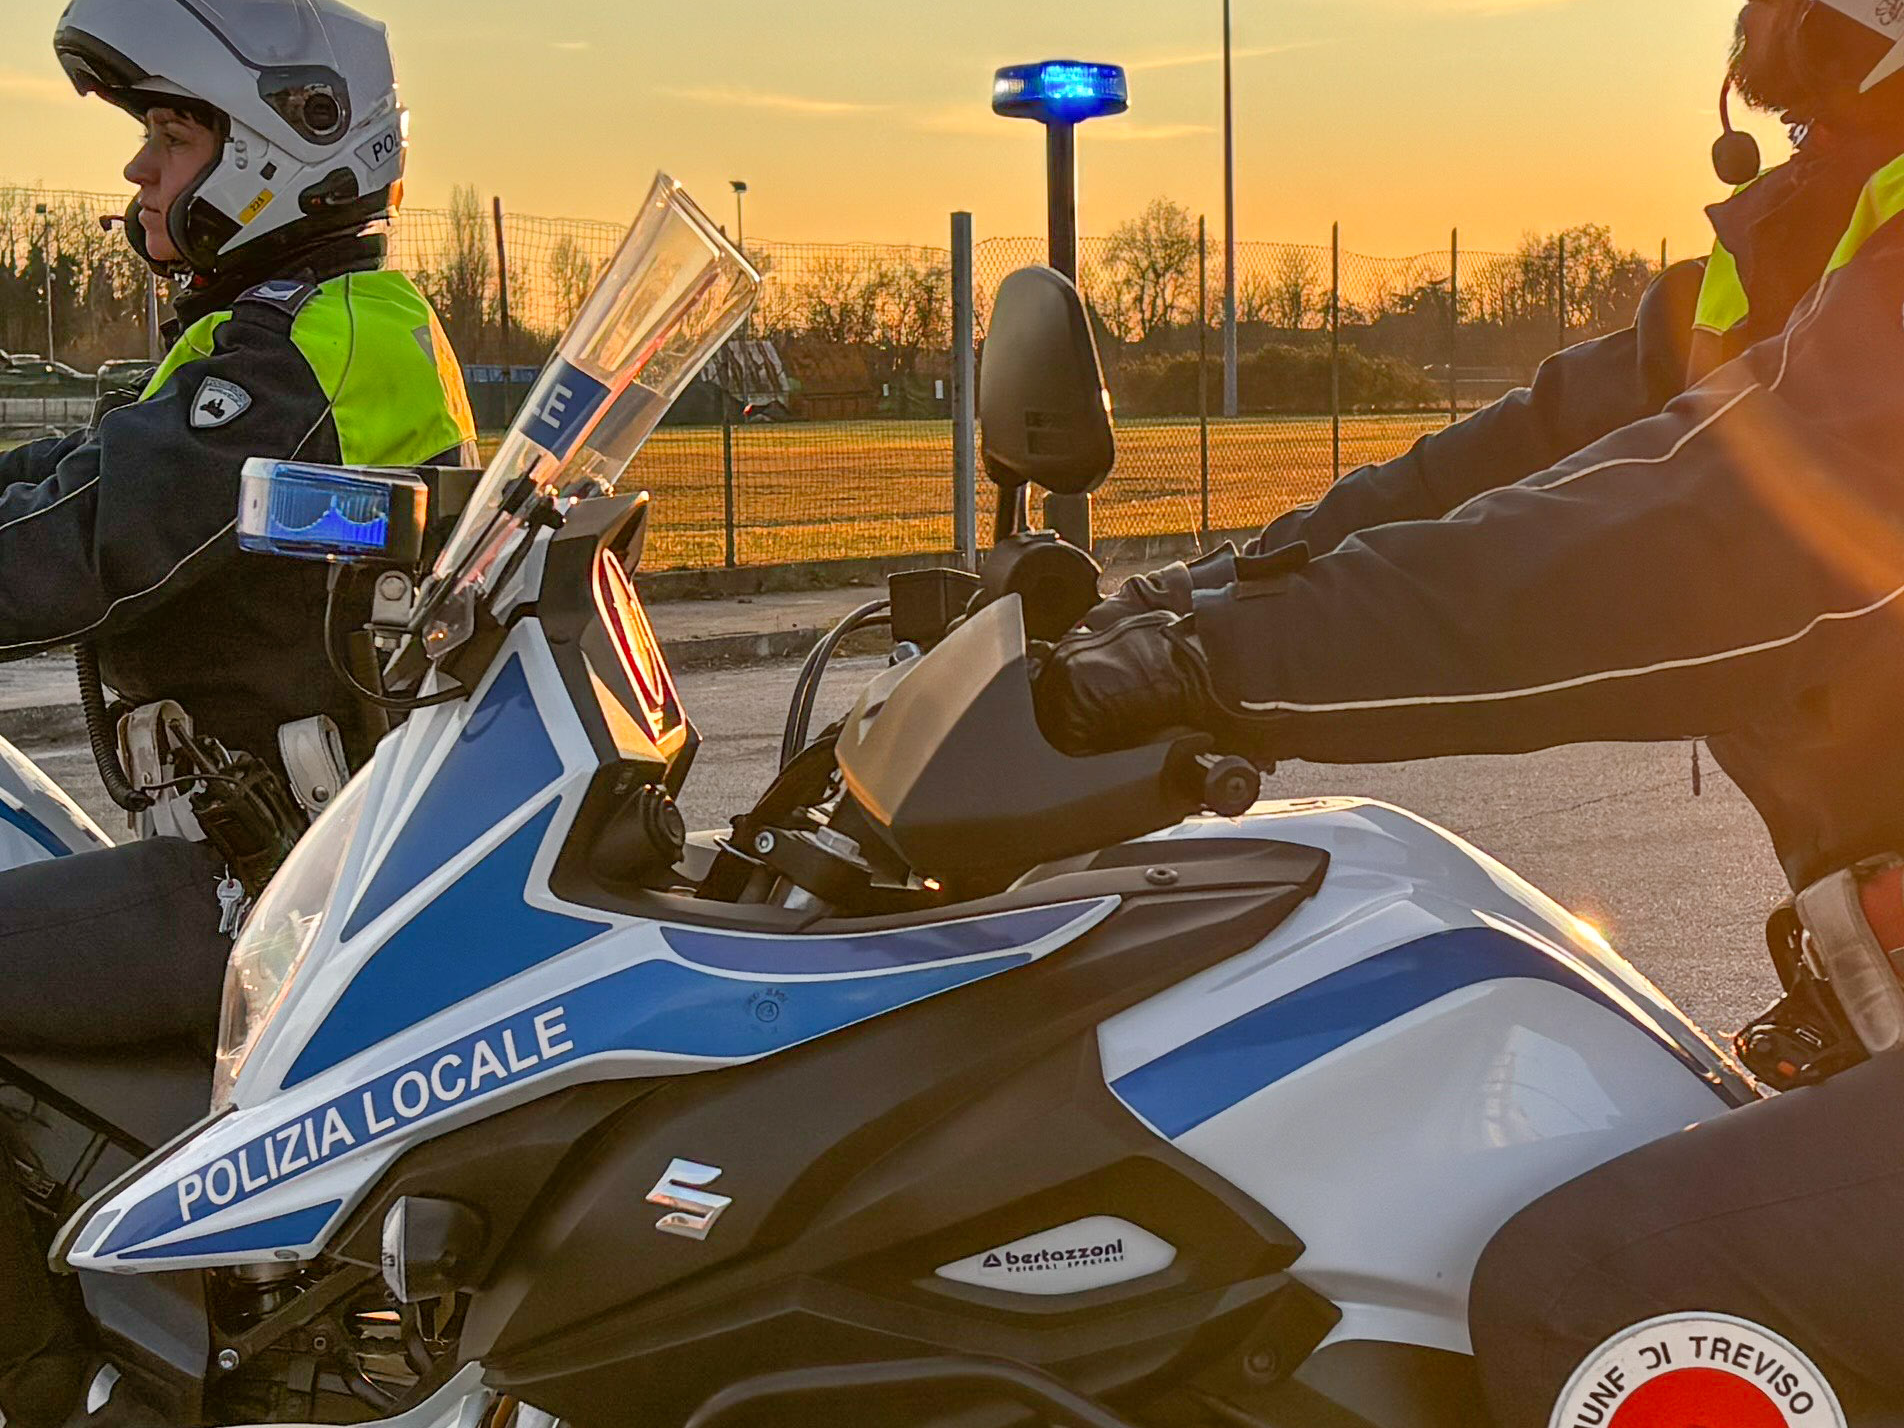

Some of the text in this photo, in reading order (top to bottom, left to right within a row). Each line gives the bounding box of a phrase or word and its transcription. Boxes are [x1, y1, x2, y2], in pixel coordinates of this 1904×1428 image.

[176, 1005, 574, 1222] POLIZIA LOCALE
[1638, 1341, 1672, 1370] DI
[1688, 1335, 1814, 1415] TREVISO
